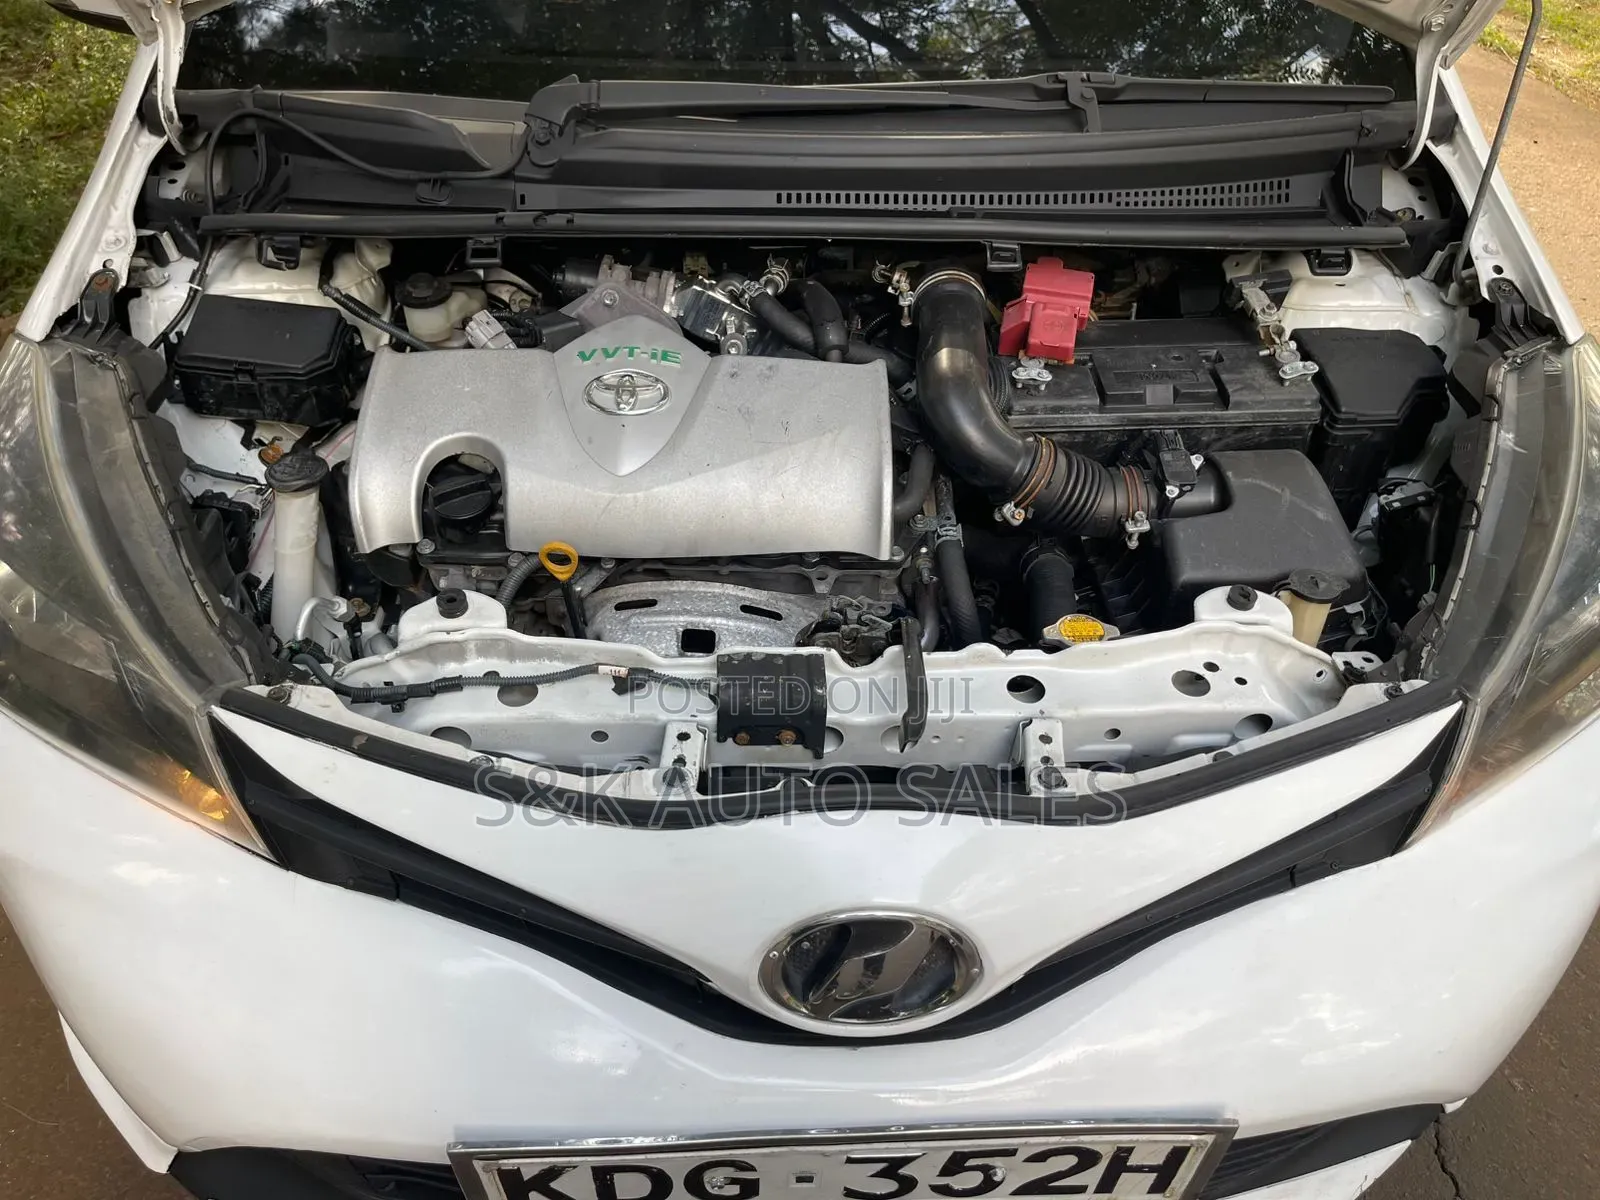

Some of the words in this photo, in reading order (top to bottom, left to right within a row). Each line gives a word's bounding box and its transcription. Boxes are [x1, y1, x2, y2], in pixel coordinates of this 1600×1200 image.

[577, 345, 682, 366] VVT-iE
[497, 1159, 760, 1200] KDG
[843, 1146, 1194, 1200] 352H
